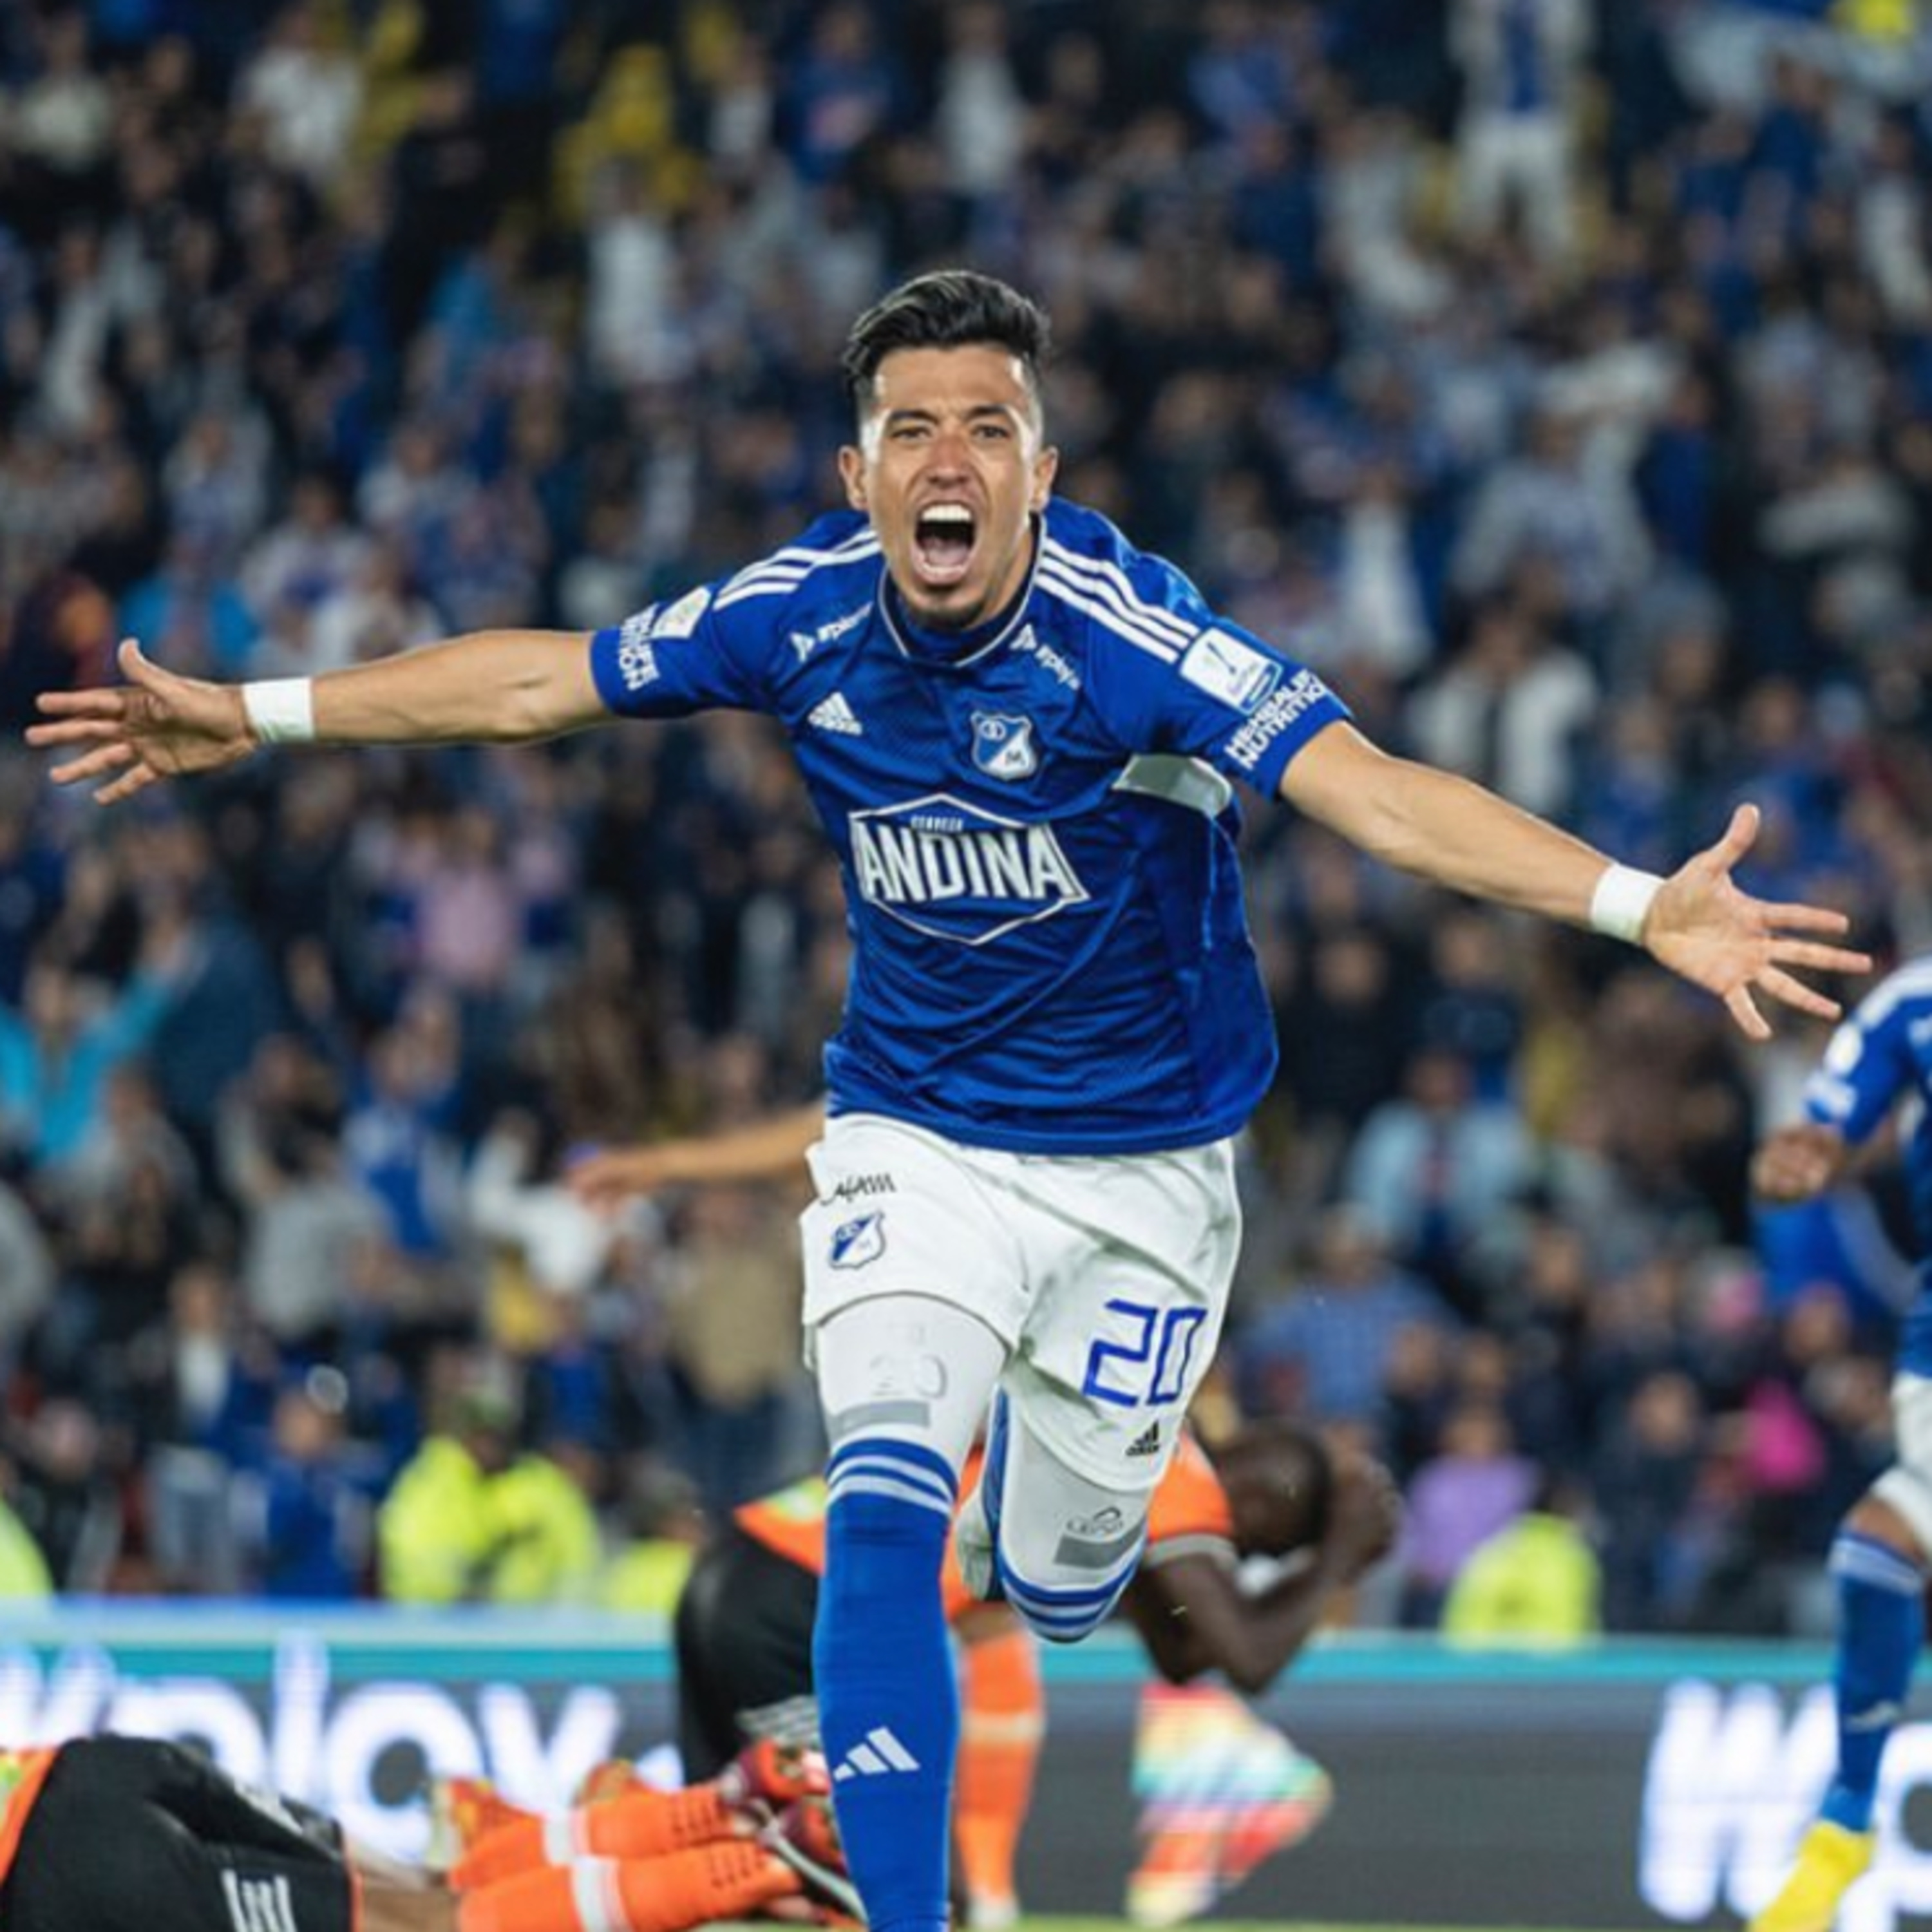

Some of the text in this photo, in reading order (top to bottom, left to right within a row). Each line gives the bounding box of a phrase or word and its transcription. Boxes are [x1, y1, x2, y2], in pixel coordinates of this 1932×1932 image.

[1233, 675, 1327, 771] NUTRITIO
[853, 819, 1080, 902] ANDINA
[1082, 1298, 1208, 1408] 20
